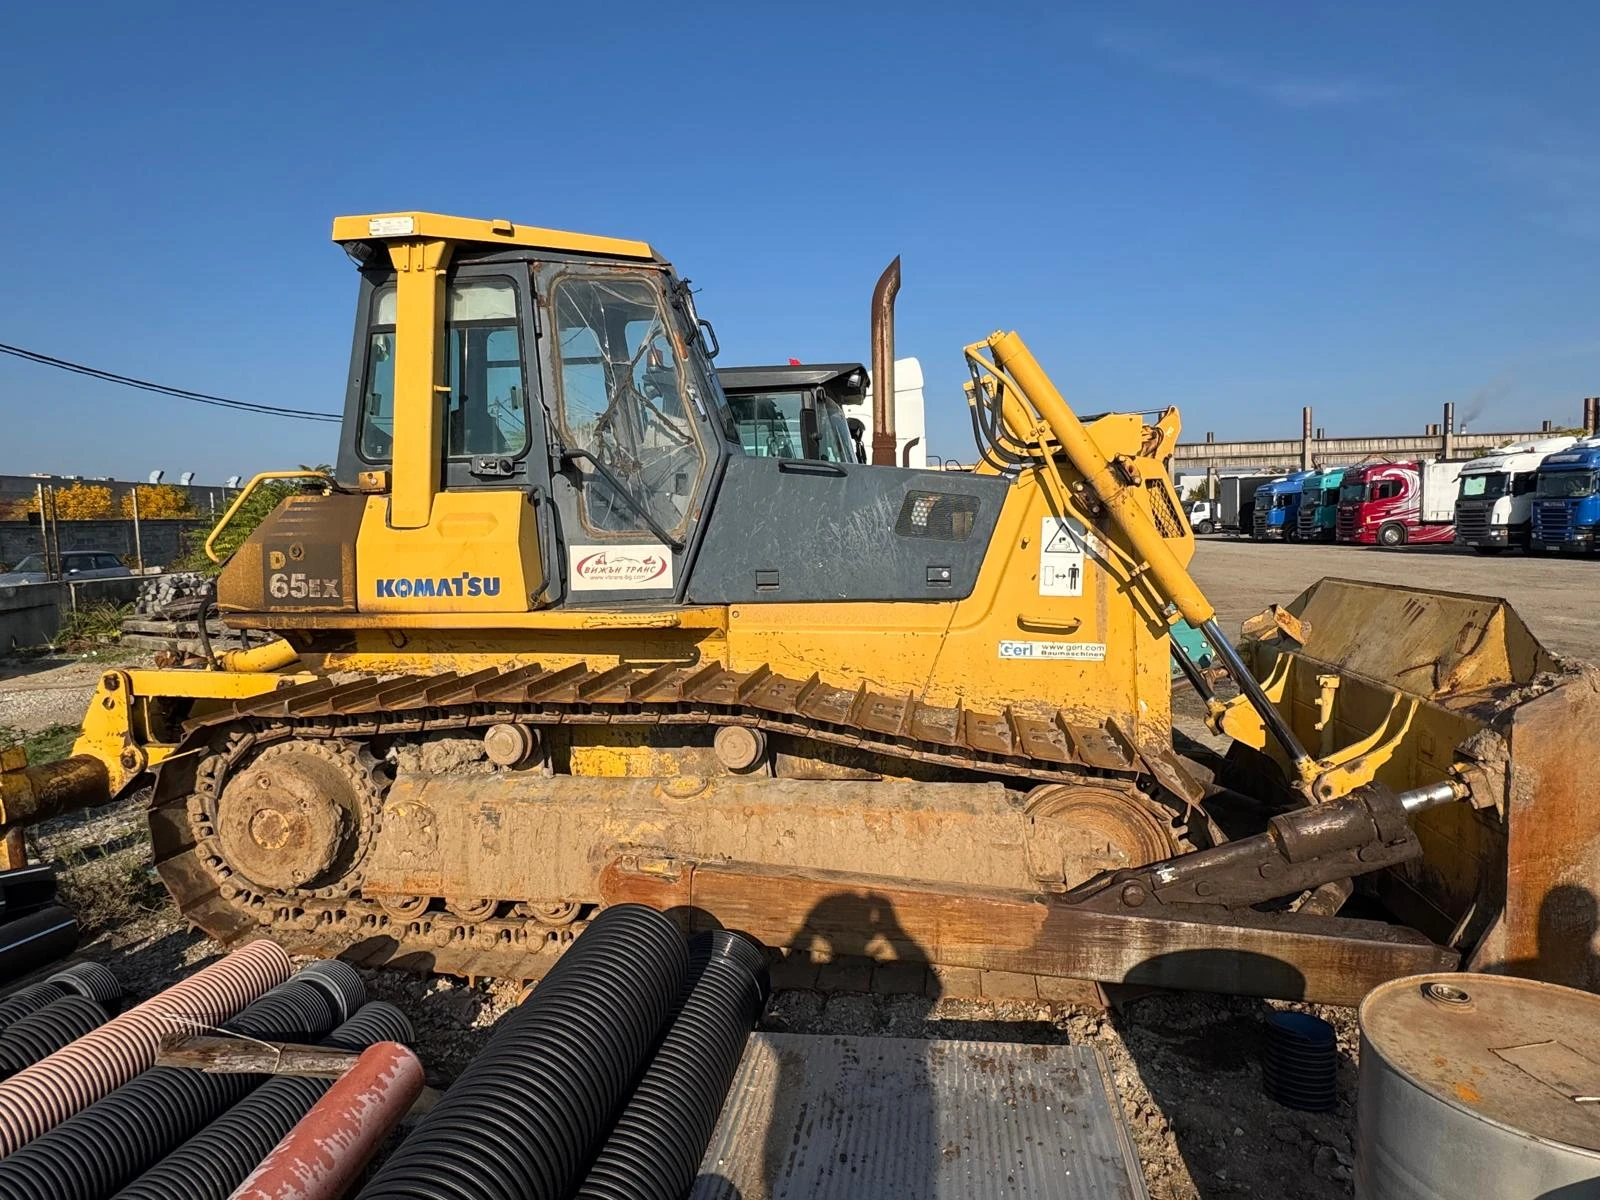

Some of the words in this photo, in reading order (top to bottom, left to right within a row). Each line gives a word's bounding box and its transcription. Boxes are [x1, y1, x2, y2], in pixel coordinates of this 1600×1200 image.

[269, 551, 286, 570] D
[584, 566, 622, 574] ВИЖЪН
[269, 573, 340, 599] 65EX
[376, 572, 501, 598] KOMATSU
